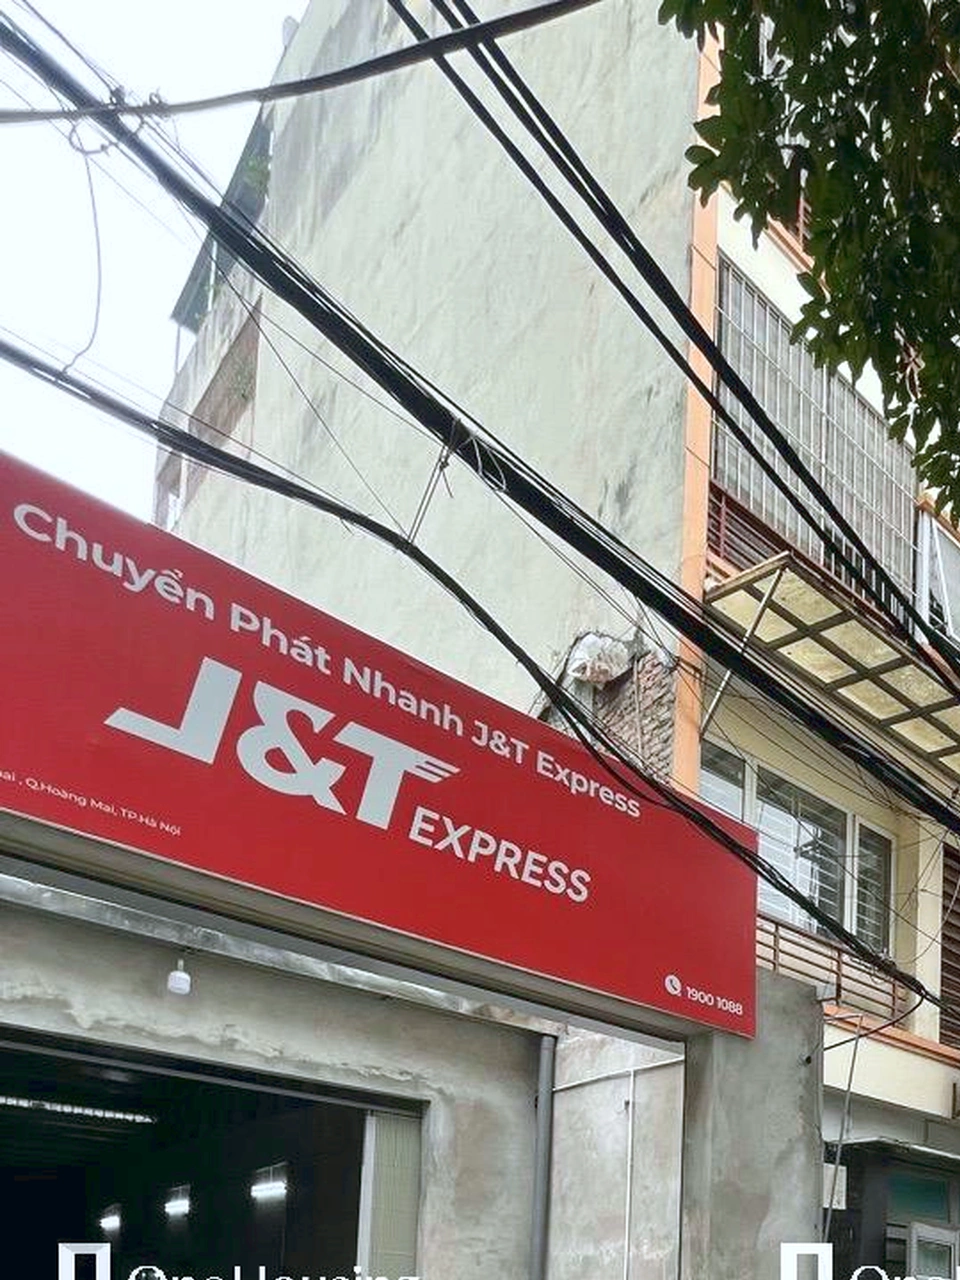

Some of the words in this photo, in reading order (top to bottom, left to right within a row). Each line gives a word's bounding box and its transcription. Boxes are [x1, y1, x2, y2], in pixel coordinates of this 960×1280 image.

[13, 503, 214, 620] Chuyển
[230, 602, 331, 675] Phát
[343, 657, 463, 737] Nhanh
[471, 719, 529, 764] J&T
[536, 750, 640, 818] Express
[104, 656, 460, 830] J&T
[409, 805, 591, 902] EXPRESS
[686, 986, 714, 1006] 1900
[716, 996, 743, 1015] 1088
